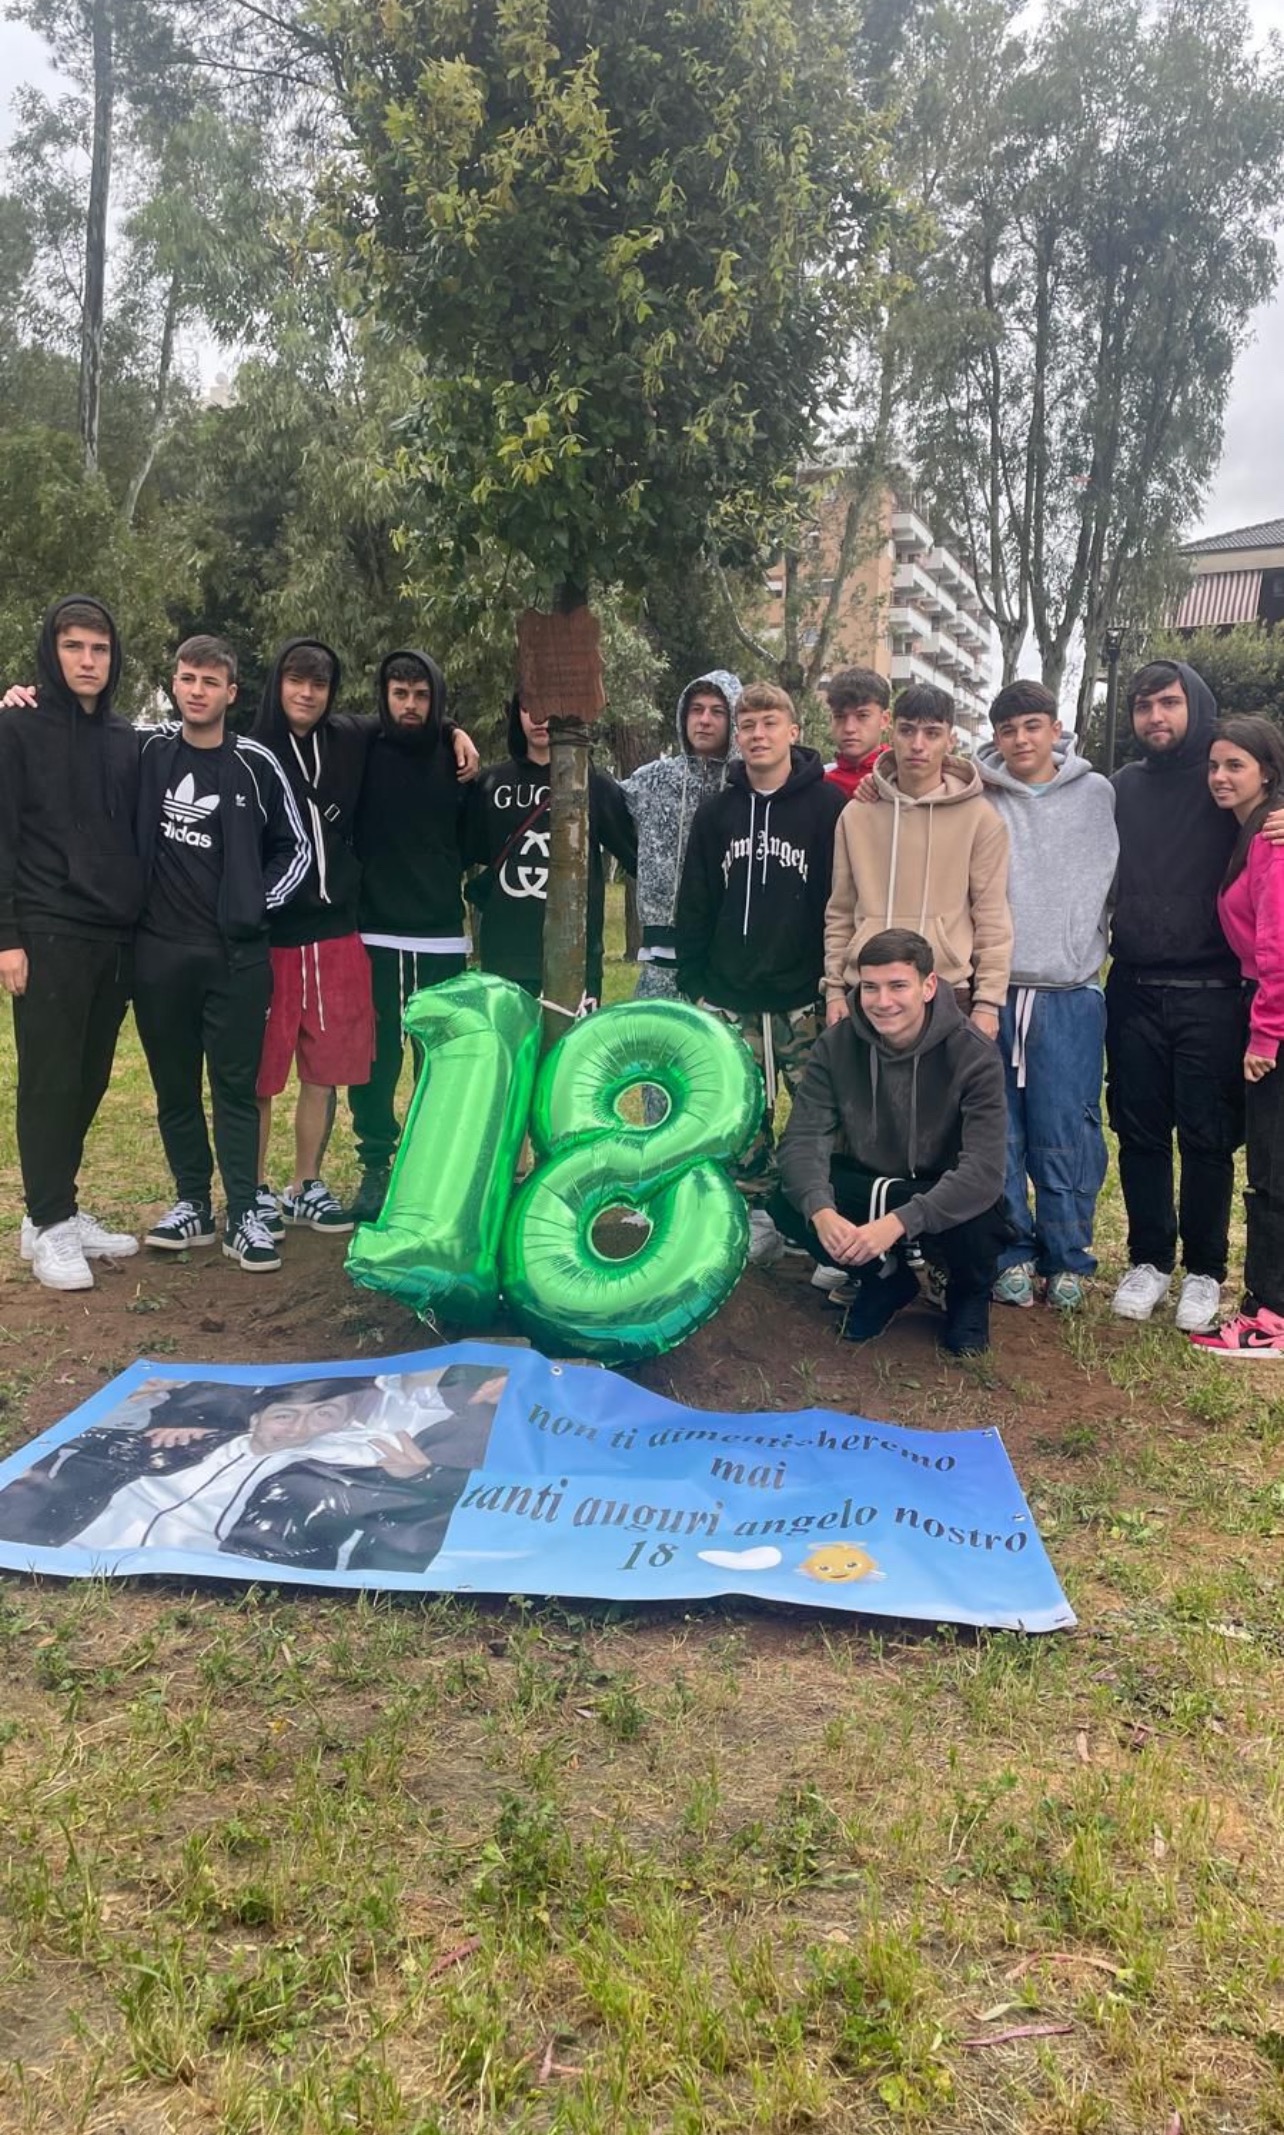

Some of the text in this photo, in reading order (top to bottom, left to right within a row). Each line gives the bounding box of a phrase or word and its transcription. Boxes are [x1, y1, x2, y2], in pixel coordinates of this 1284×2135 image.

[494, 784, 551, 811] GUC
[343, 967, 766, 1368] 18
[528, 1403, 599, 1442] non
[610, 1428, 639, 1450] ti
[710, 1454, 787, 1490] mai
[460, 1478, 1028, 1553] tanti auguri angelo nostro
[617, 1540, 679, 1570] 18
